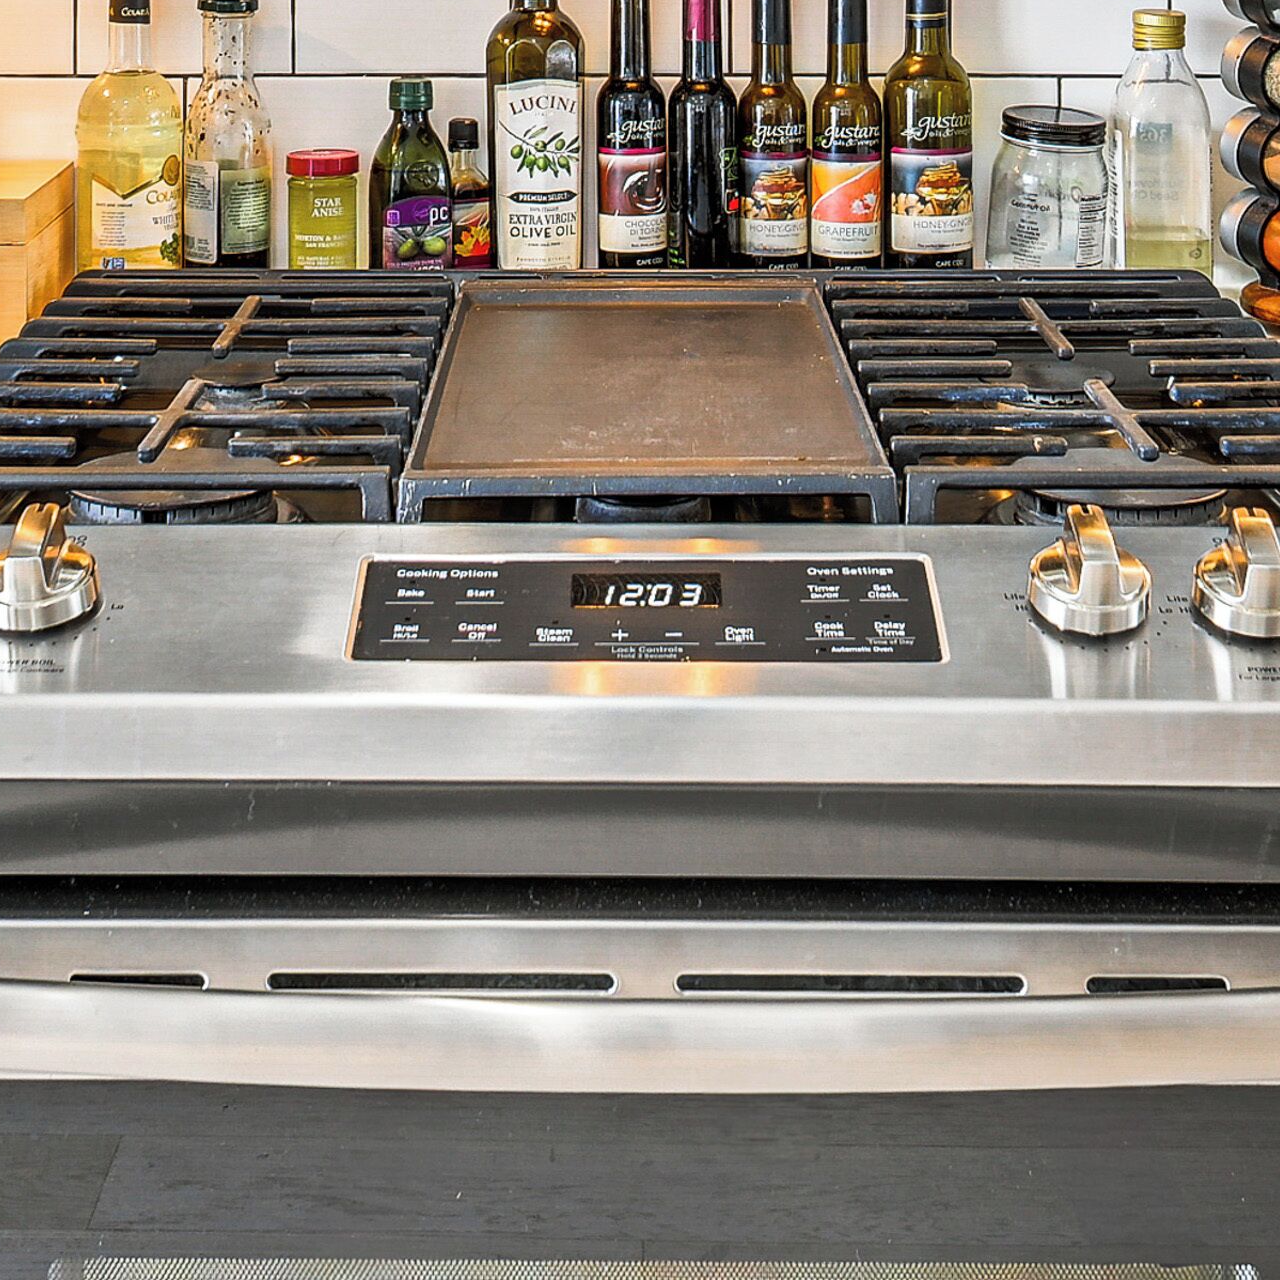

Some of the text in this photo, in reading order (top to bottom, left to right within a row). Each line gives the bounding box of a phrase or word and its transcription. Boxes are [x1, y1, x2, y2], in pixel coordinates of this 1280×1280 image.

[313, 198, 342, 208] STAR
[311, 208, 345, 218] ANISE
[508, 212, 577, 226] EXTRA VIRGIN
[509, 224, 577, 238] OLIVE OIL
[818, 224, 878, 237] GRAPEFRUIT
[396, 569, 499, 579] Cooking Options
[807, 566, 894, 576] Oven Settings
[807, 584, 841, 592] Timer
[872, 584, 892, 592] Set
[397, 588, 425, 598] Bake
[466, 588, 495, 598] Start
[604, 583, 702, 607] 12:03
[867, 591, 900, 599] Clock
[458, 623, 497, 632] Cancel
[814, 622, 844, 630] Cook
[874, 622, 906, 630] Delay
[535, 628, 573, 636] Steam
[724, 627, 754, 635] Oven
[725, 634, 755, 642] Light
[611, 646, 684, 654] Lock Controls
[831, 646, 872, 654] Automatic
